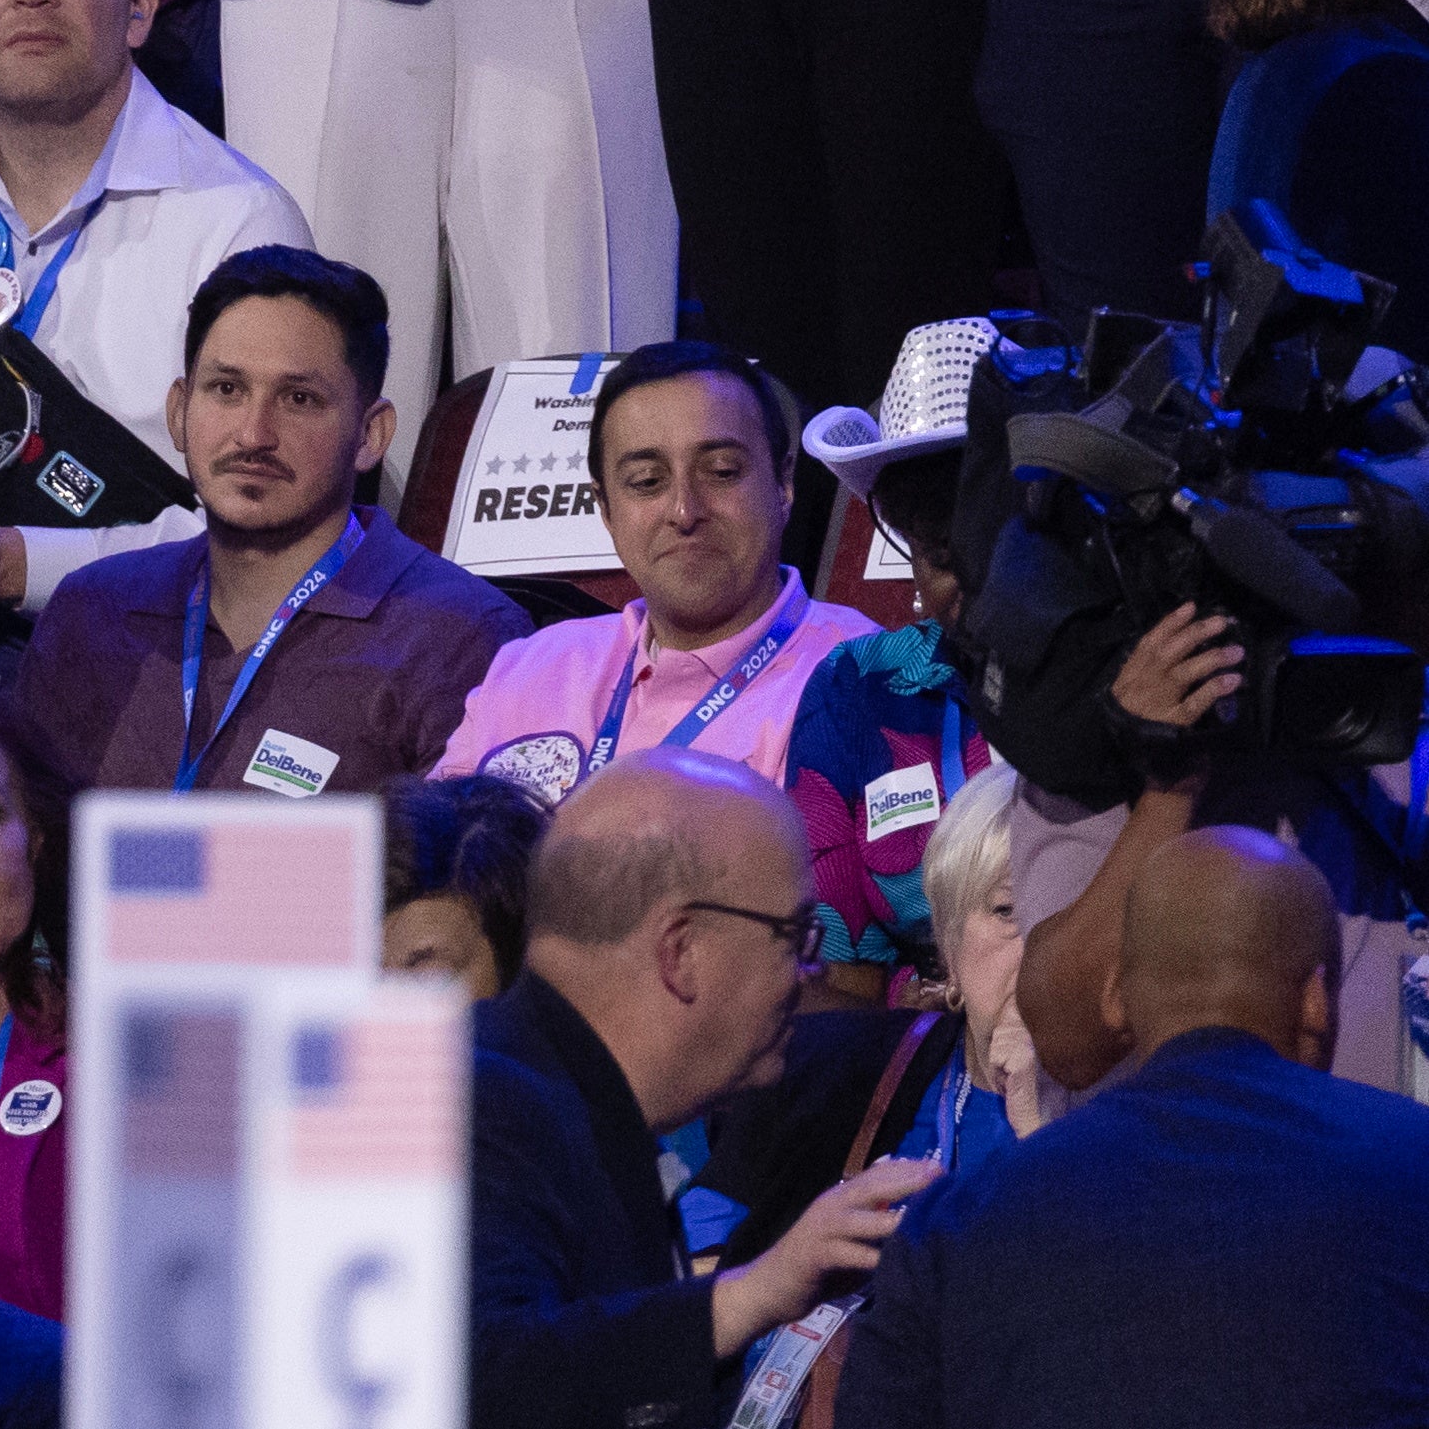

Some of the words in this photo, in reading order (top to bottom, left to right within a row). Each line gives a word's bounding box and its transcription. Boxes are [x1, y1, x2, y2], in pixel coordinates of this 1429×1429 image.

[253, 618, 283, 658] DNC
[287, 570, 327, 609] 2024
[695, 683, 736, 722] DNC
[739, 637, 778, 679] 2024
[255, 749, 323, 784] DelBene
[588, 737, 614, 772] DNC
